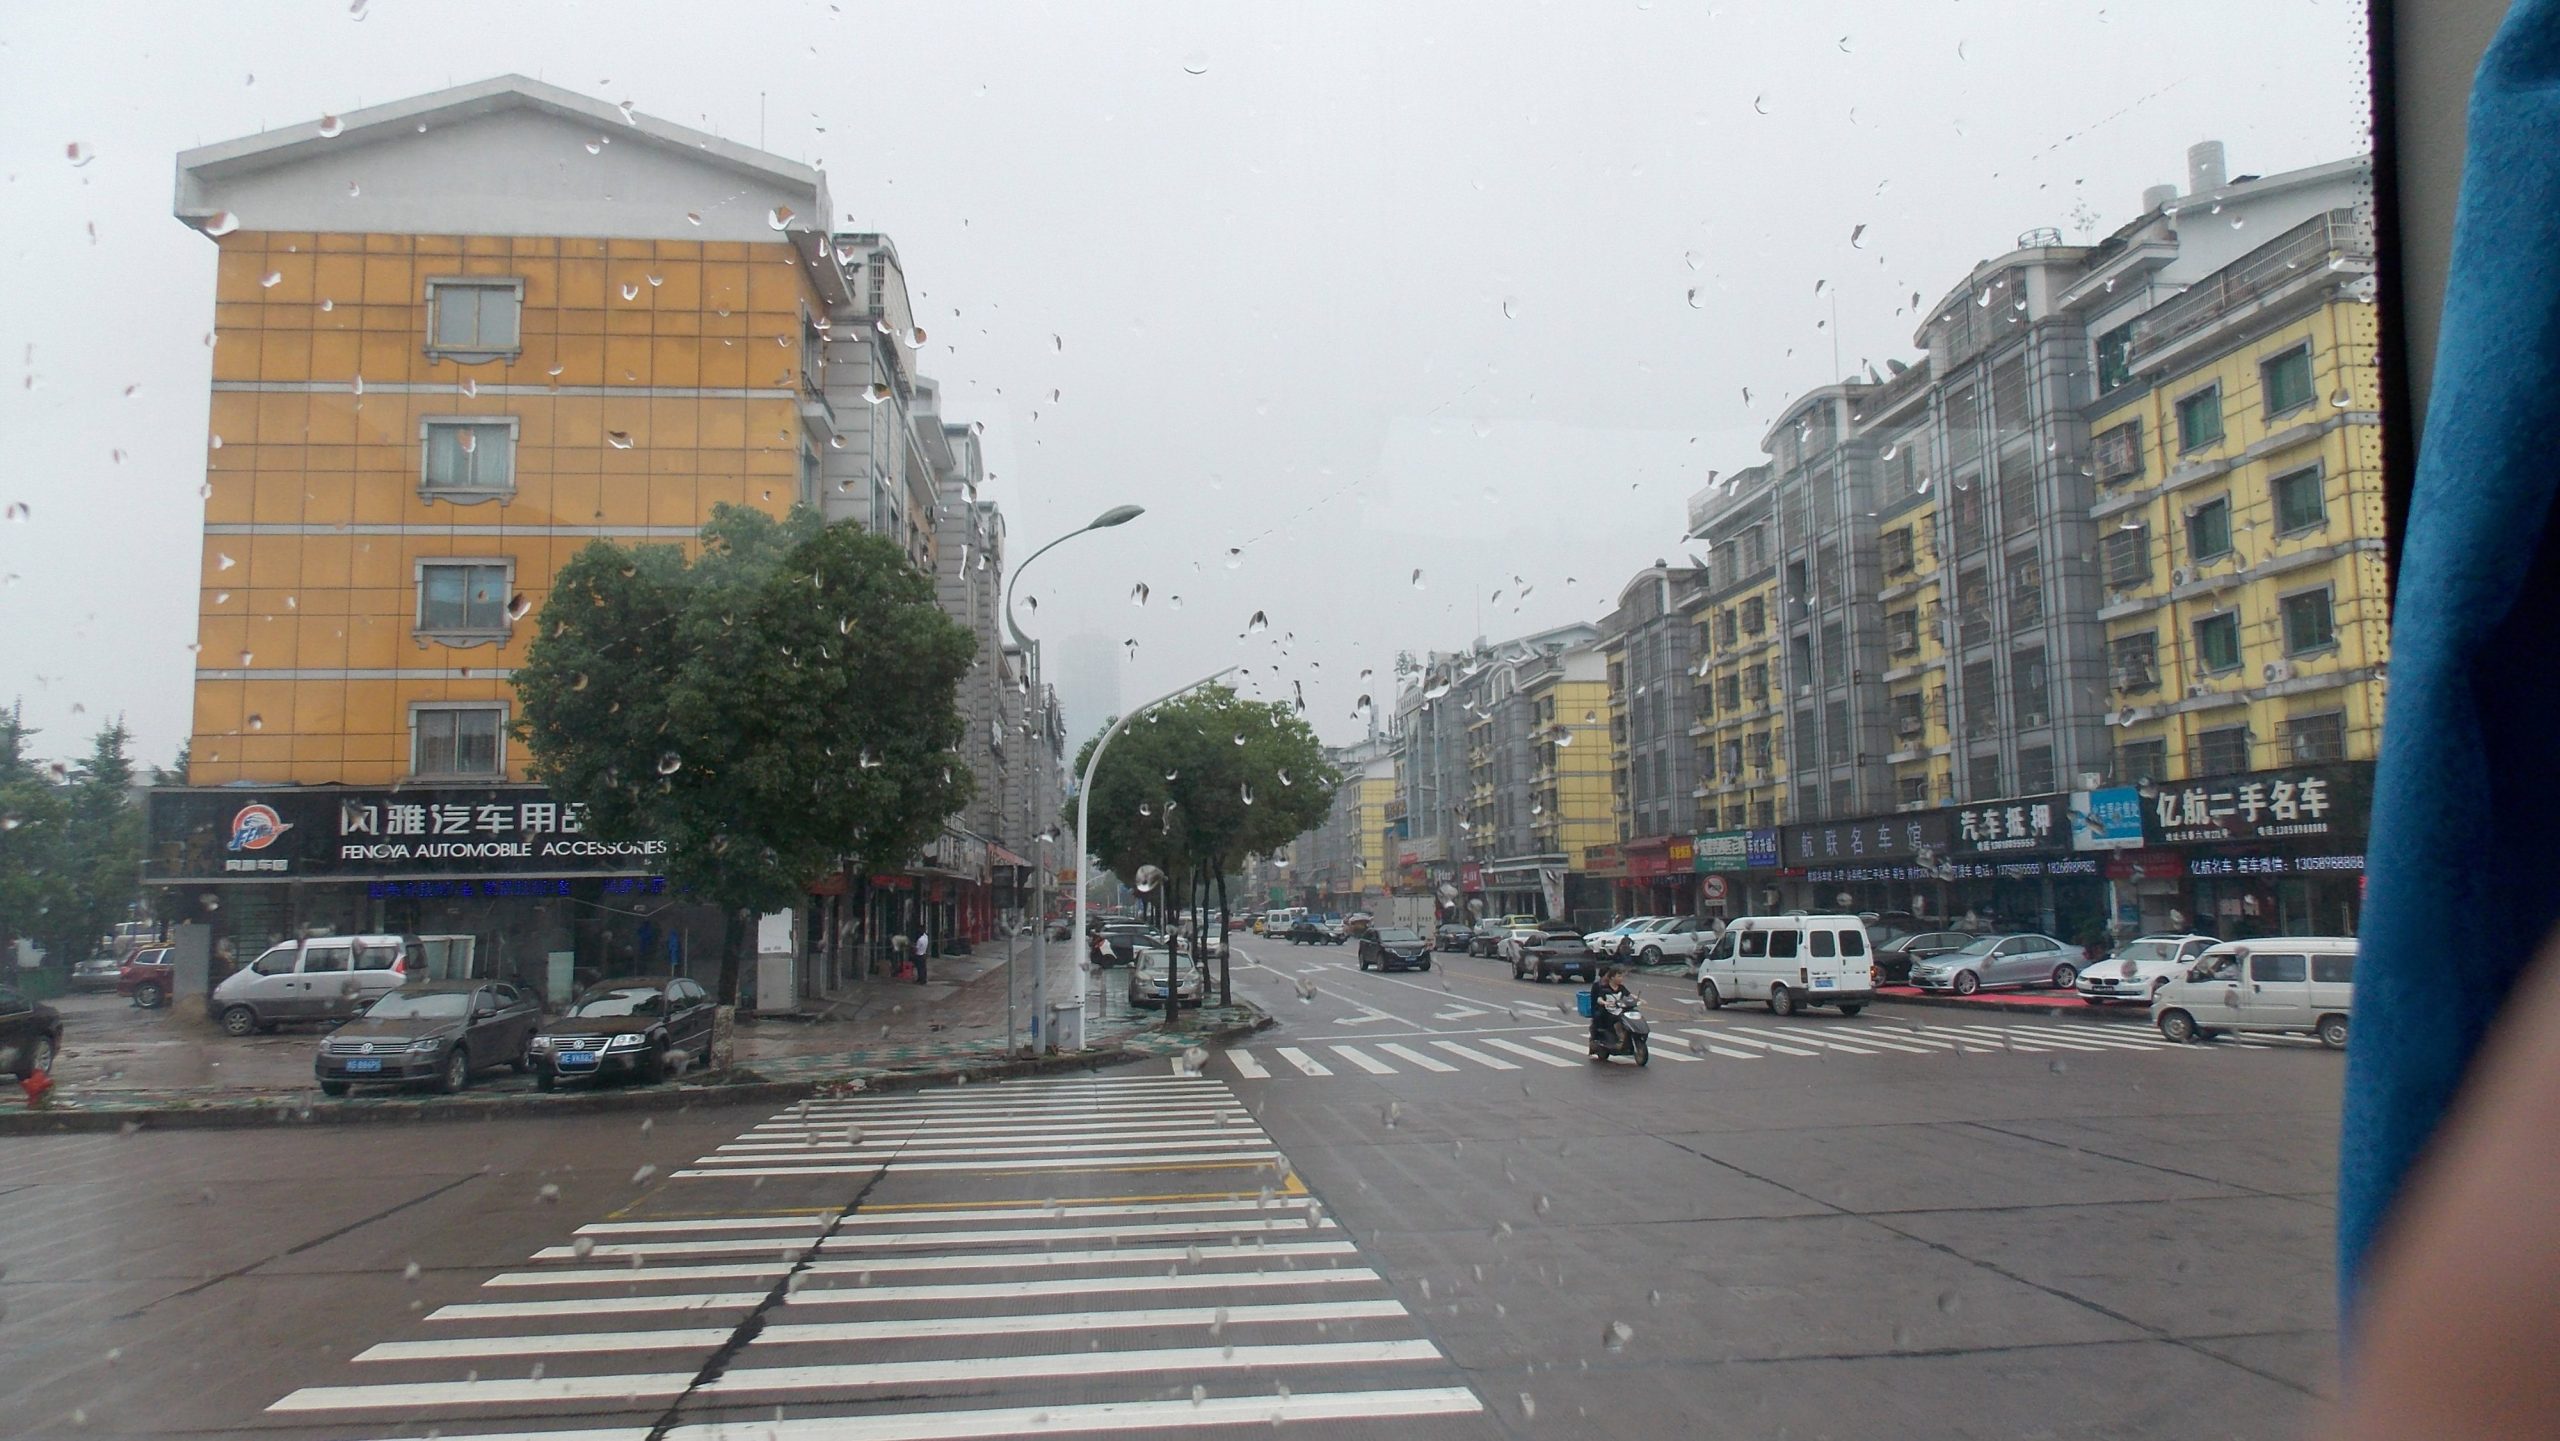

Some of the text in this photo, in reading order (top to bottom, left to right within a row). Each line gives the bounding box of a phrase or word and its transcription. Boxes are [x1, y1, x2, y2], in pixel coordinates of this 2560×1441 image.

[2156, 777, 2331, 828] 亿航二手名车
[1801, 821, 1922, 858] 航联名车馆
[1961, 804, 2052, 841] 汽车抵押
[341, 841, 667, 859] FENGYA AUTOMOBILE ACCESSORIES
